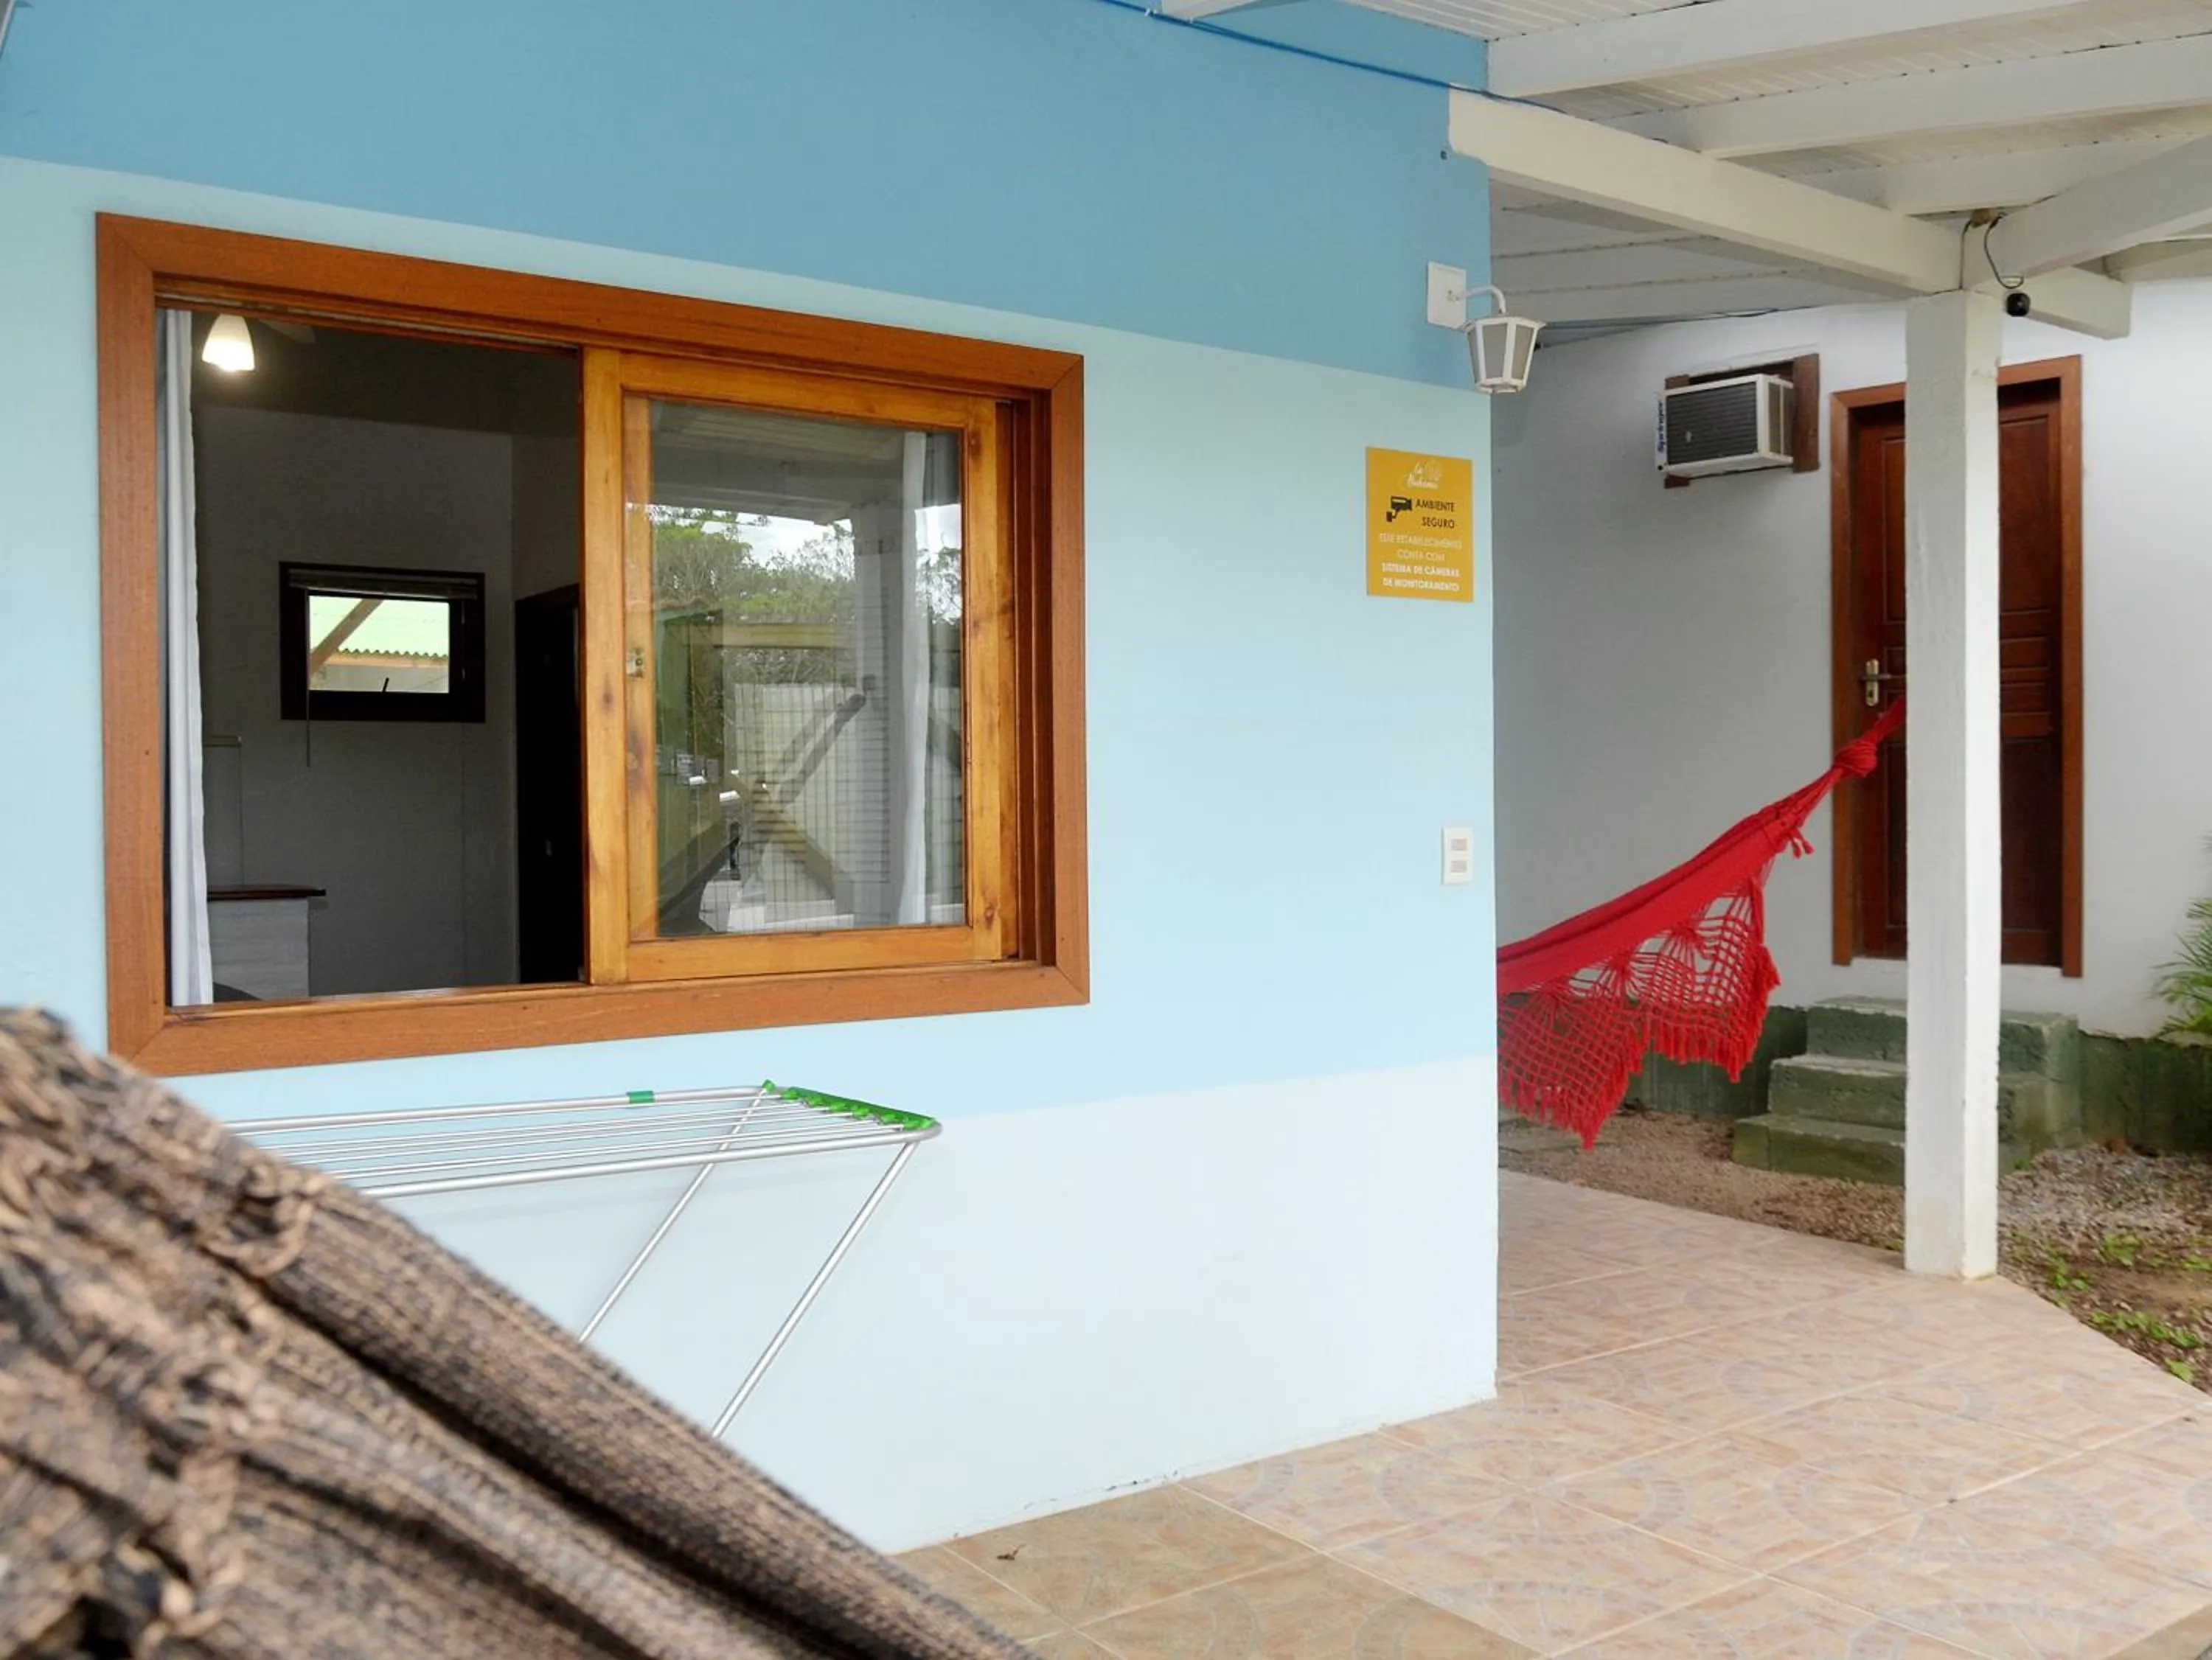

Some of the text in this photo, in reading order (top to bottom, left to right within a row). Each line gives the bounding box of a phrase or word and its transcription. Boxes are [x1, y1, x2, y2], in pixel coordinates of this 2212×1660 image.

[1416, 499, 1455, 512] AMBIENTE
[1422, 517, 1455, 529] SEGURO
[1397, 550, 1445, 562] CONTA COM
[1382, 562, 1411, 573] SISTEMA
[1413, 565, 1423, 574] DE
[1382, 577, 1461, 592] DE MONITORAMENTO
